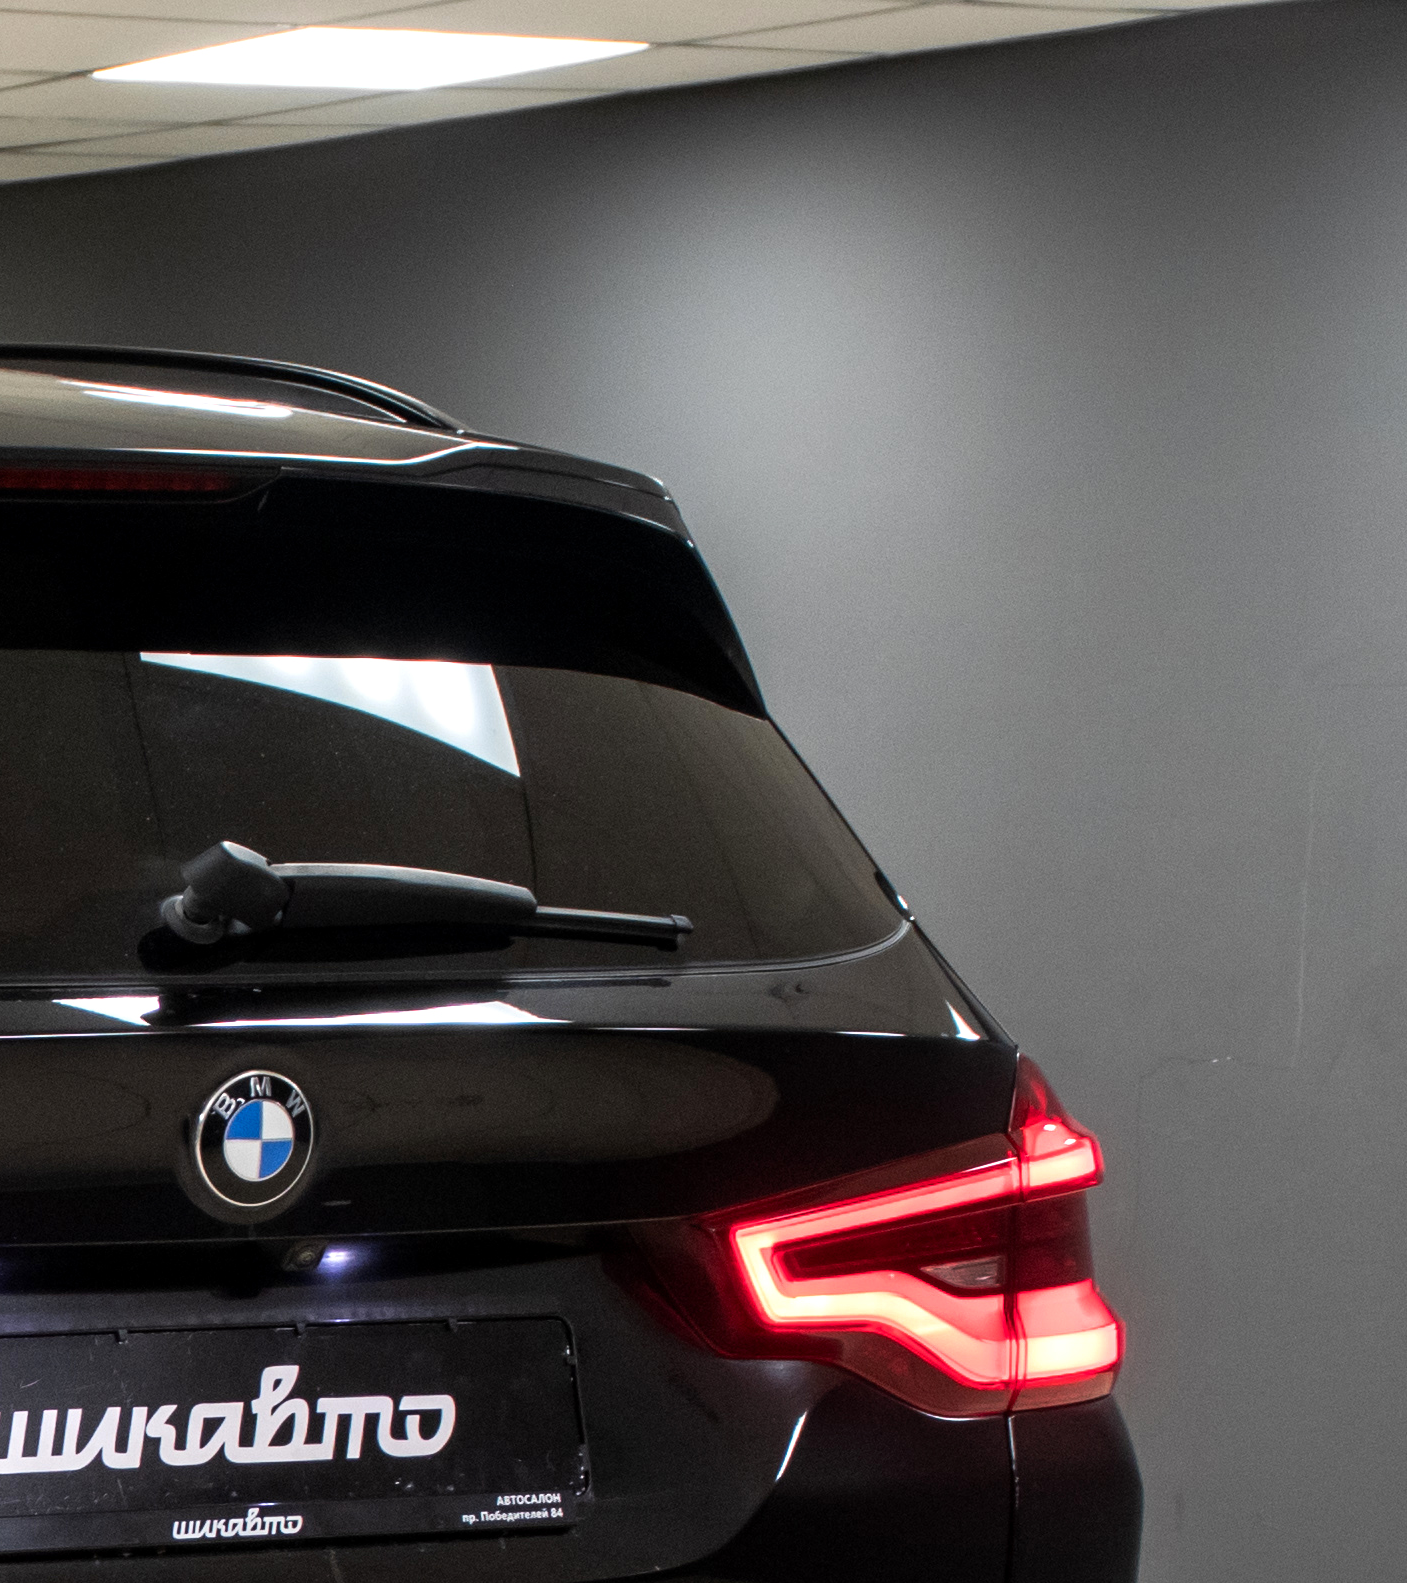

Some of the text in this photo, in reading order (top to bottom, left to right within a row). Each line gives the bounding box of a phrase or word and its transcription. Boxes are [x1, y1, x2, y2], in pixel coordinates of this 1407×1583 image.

[213, 1076, 306, 1121] BMW
[496, 1493, 562, 1506] АВТОСАЛОН
[172, 1507, 304, 1540] шикавто
[461, 1507, 564, 1525] пр. Победителей 84
